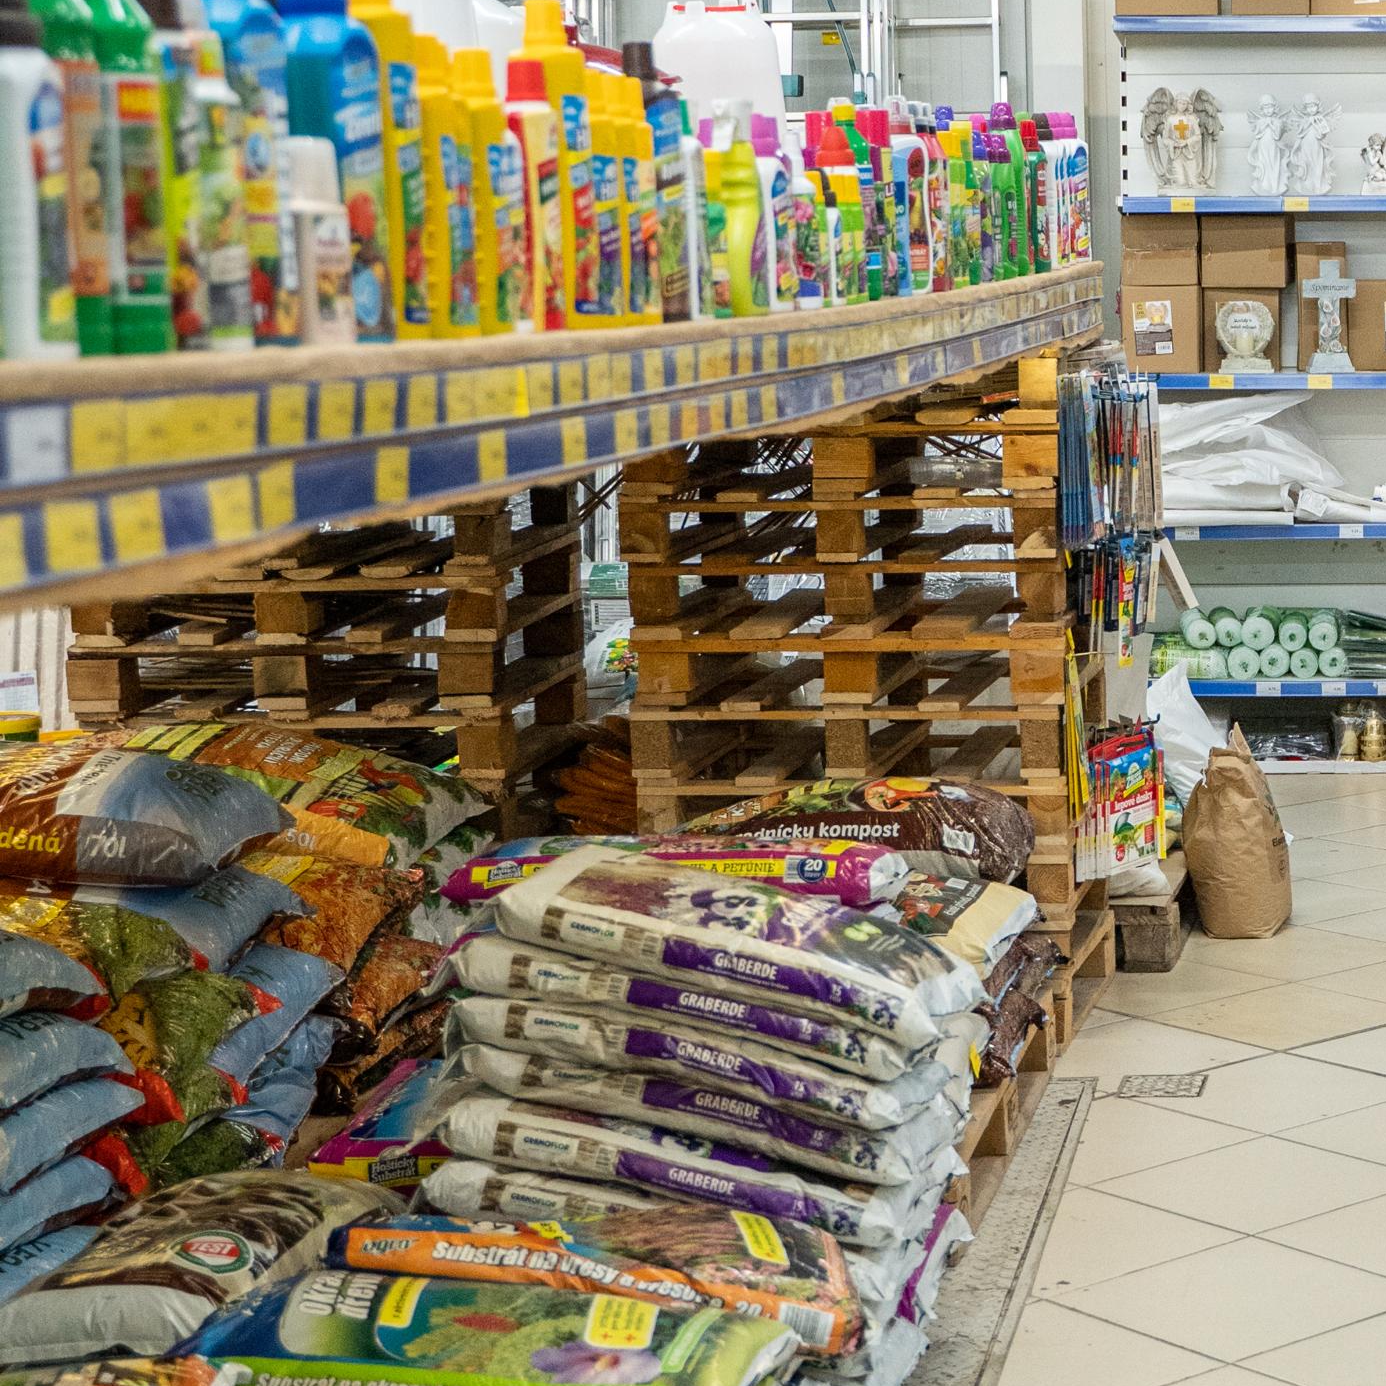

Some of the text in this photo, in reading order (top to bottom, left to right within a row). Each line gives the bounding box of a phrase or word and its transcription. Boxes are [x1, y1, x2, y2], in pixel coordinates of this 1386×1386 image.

[818, 822, 901, 840] kompost
[804, 859, 823, 871] 20
[714, 951, 778, 981] GRABERDE
[679, 991, 746, 1018] GRABERDE
[676, 1041, 742, 1071] GRABERDE
[694, 1091, 760, 1121] GRABERDE
[668, 1166, 735, 1196] GRABERDE
[190, 1241, 232, 1260] TEST
[432, 1239, 529, 1267] Substrát
[529, 1250, 557, 1272] na
[560, 1256, 618, 1286] vresy
